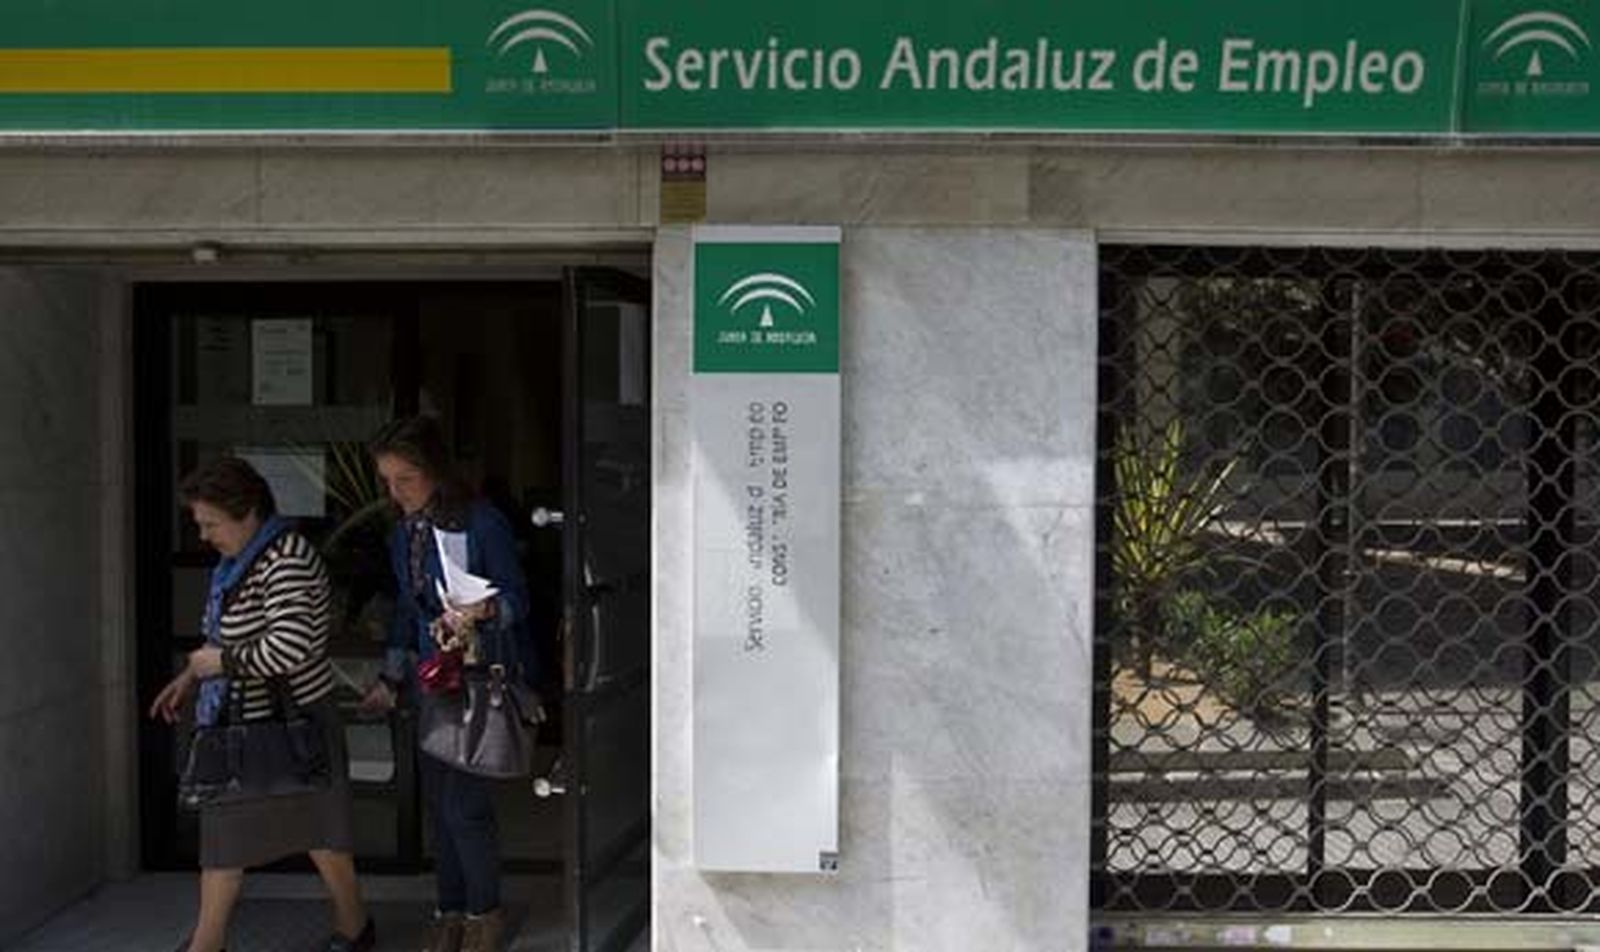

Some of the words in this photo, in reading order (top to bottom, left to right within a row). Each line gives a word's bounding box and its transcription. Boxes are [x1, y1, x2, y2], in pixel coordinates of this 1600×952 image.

[644, 37, 861, 92] Servicio
[880, 37, 1115, 92] Andaluz
[1132, 38, 1199, 92] de
[1219, 39, 1426, 108] Empleo
[771, 401, 787, 465] EMPEO
[745, 506, 763, 570] ndaluz
